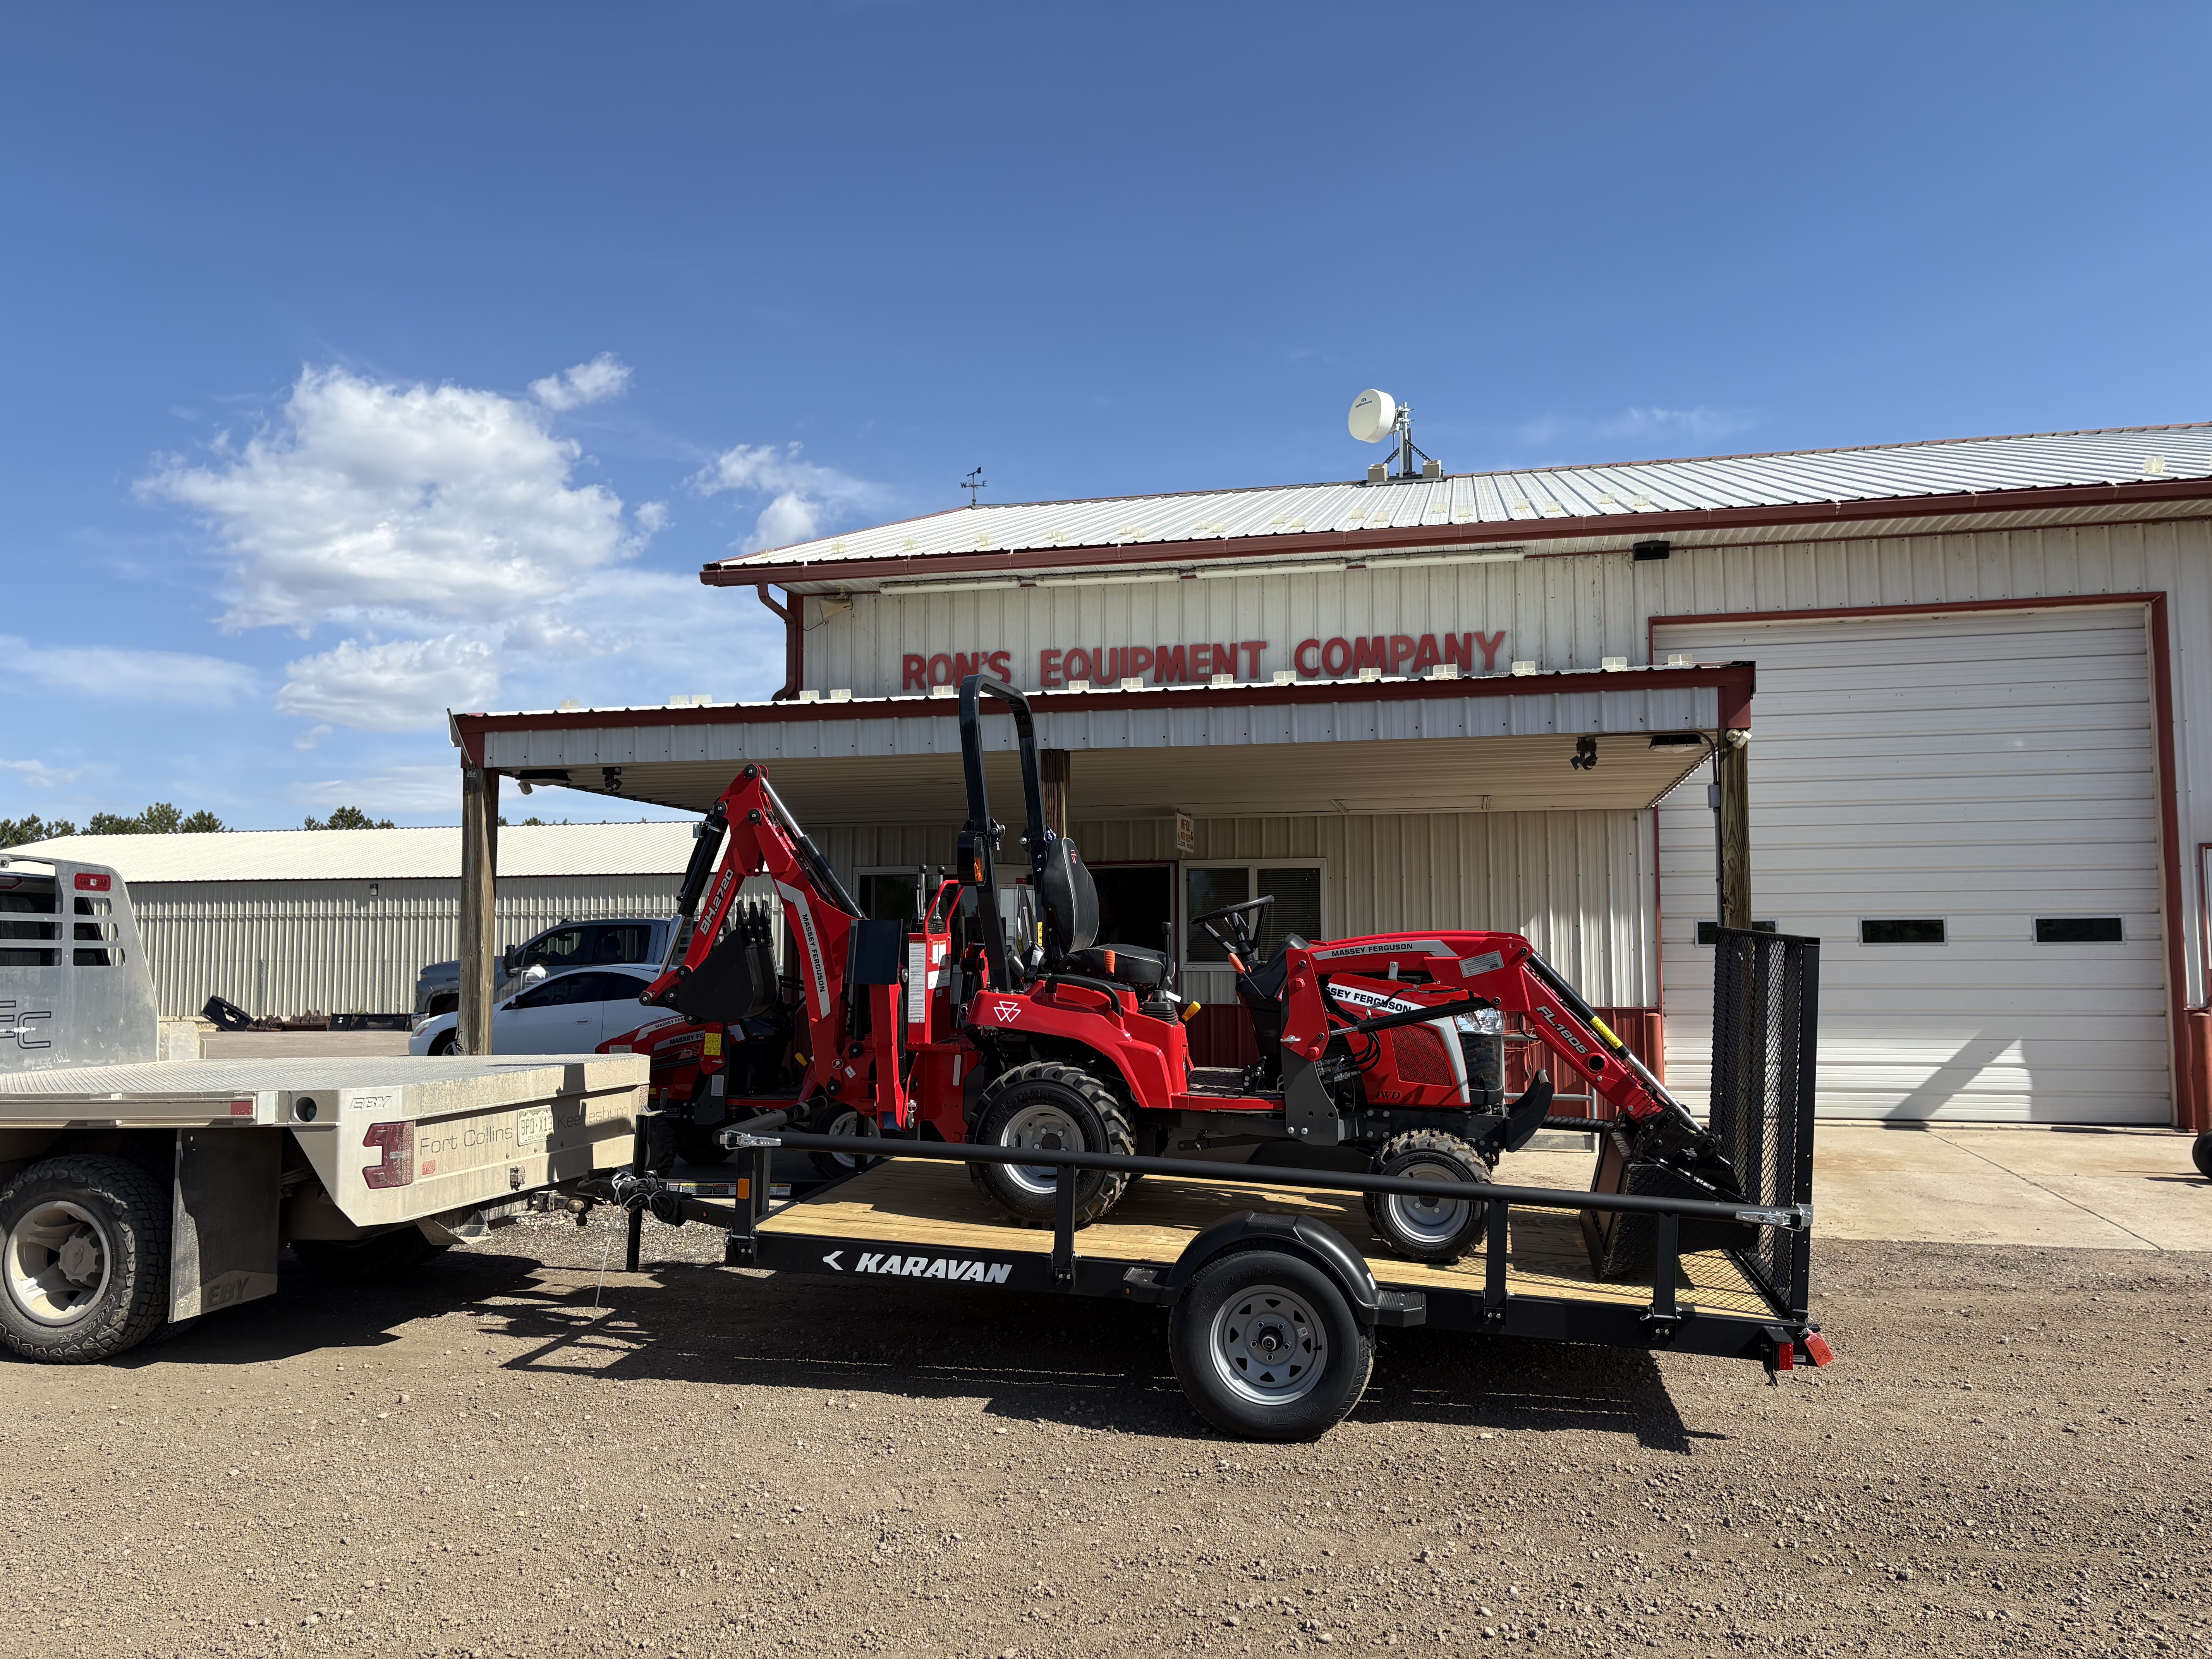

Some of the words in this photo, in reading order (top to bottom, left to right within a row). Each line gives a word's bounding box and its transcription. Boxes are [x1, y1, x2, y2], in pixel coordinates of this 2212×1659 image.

[903, 651, 1010, 690] RON'S
[1040, 641, 1267, 687] EQUIPMENT
[1294, 631, 1506, 677] COMPANY
[700, 868, 733, 936] BH.2720
[802, 914, 816, 946] MASSEY
[812, 949, 825, 992] FERGUSON
[1331, 947, 1365, 957] MASSEY
[1369, 943, 1413, 953] FERGUSON
[655, 1020, 674, 1029] MASSEY
[669, 1034, 694, 1045] MASSEY
[1536, 1005, 1589, 1054] FL.1805
[349, 1096, 392, 1110] EBY
[558, 1106, 628, 1130] Keenesburg
[420, 1135, 457, 1156] Fort
[464, 1126, 513, 1147] Collins
[854, 1253, 1013, 1283] KARAVAN
[205, 1276, 250, 1308] EBY
